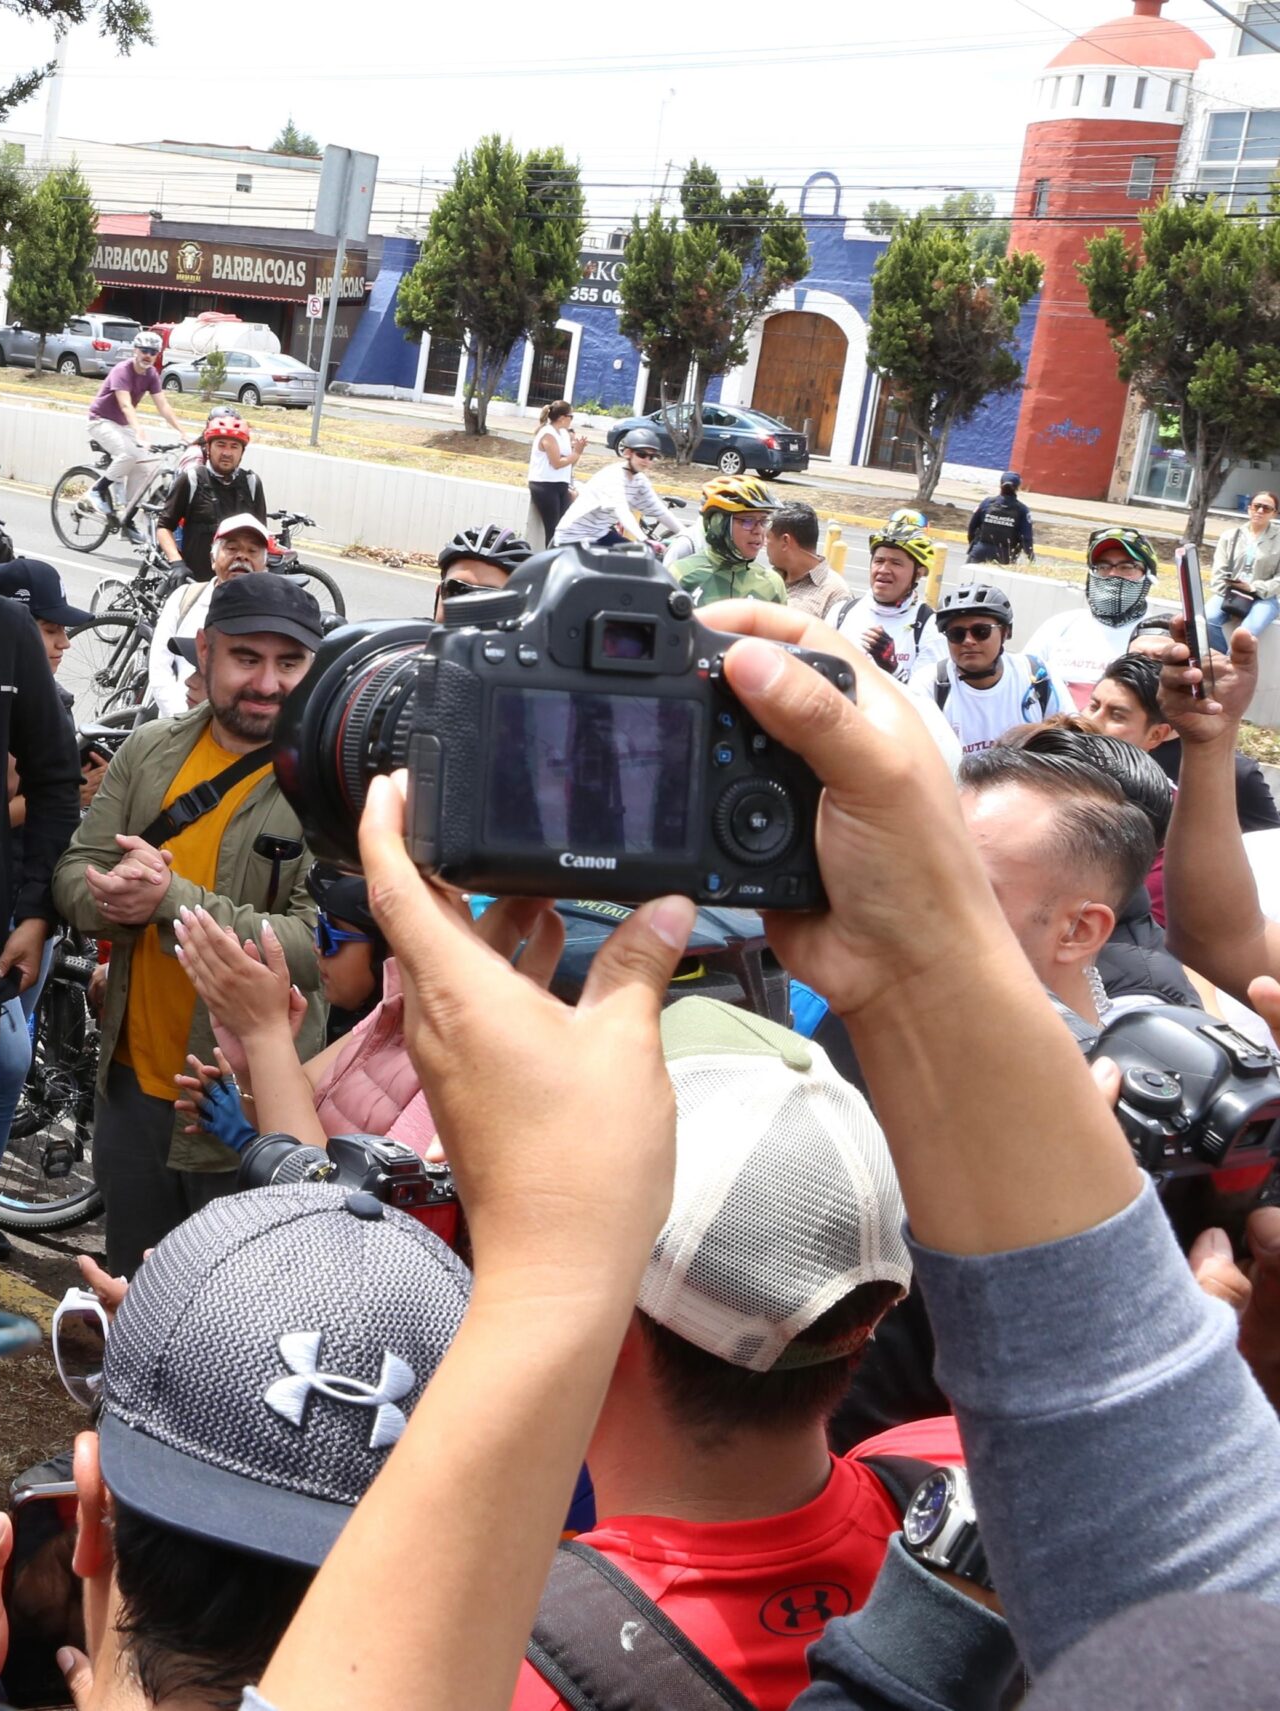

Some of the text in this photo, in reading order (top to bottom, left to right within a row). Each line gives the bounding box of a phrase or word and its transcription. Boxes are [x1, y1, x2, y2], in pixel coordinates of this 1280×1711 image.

[212, 254, 306, 287] BARBACOAS
[316, 277, 365, 298] BARACOAS
[602, 289, 625, 304] 06
[752, 818, 767, 827] SET
[559, 853, 617, 870] Canon
